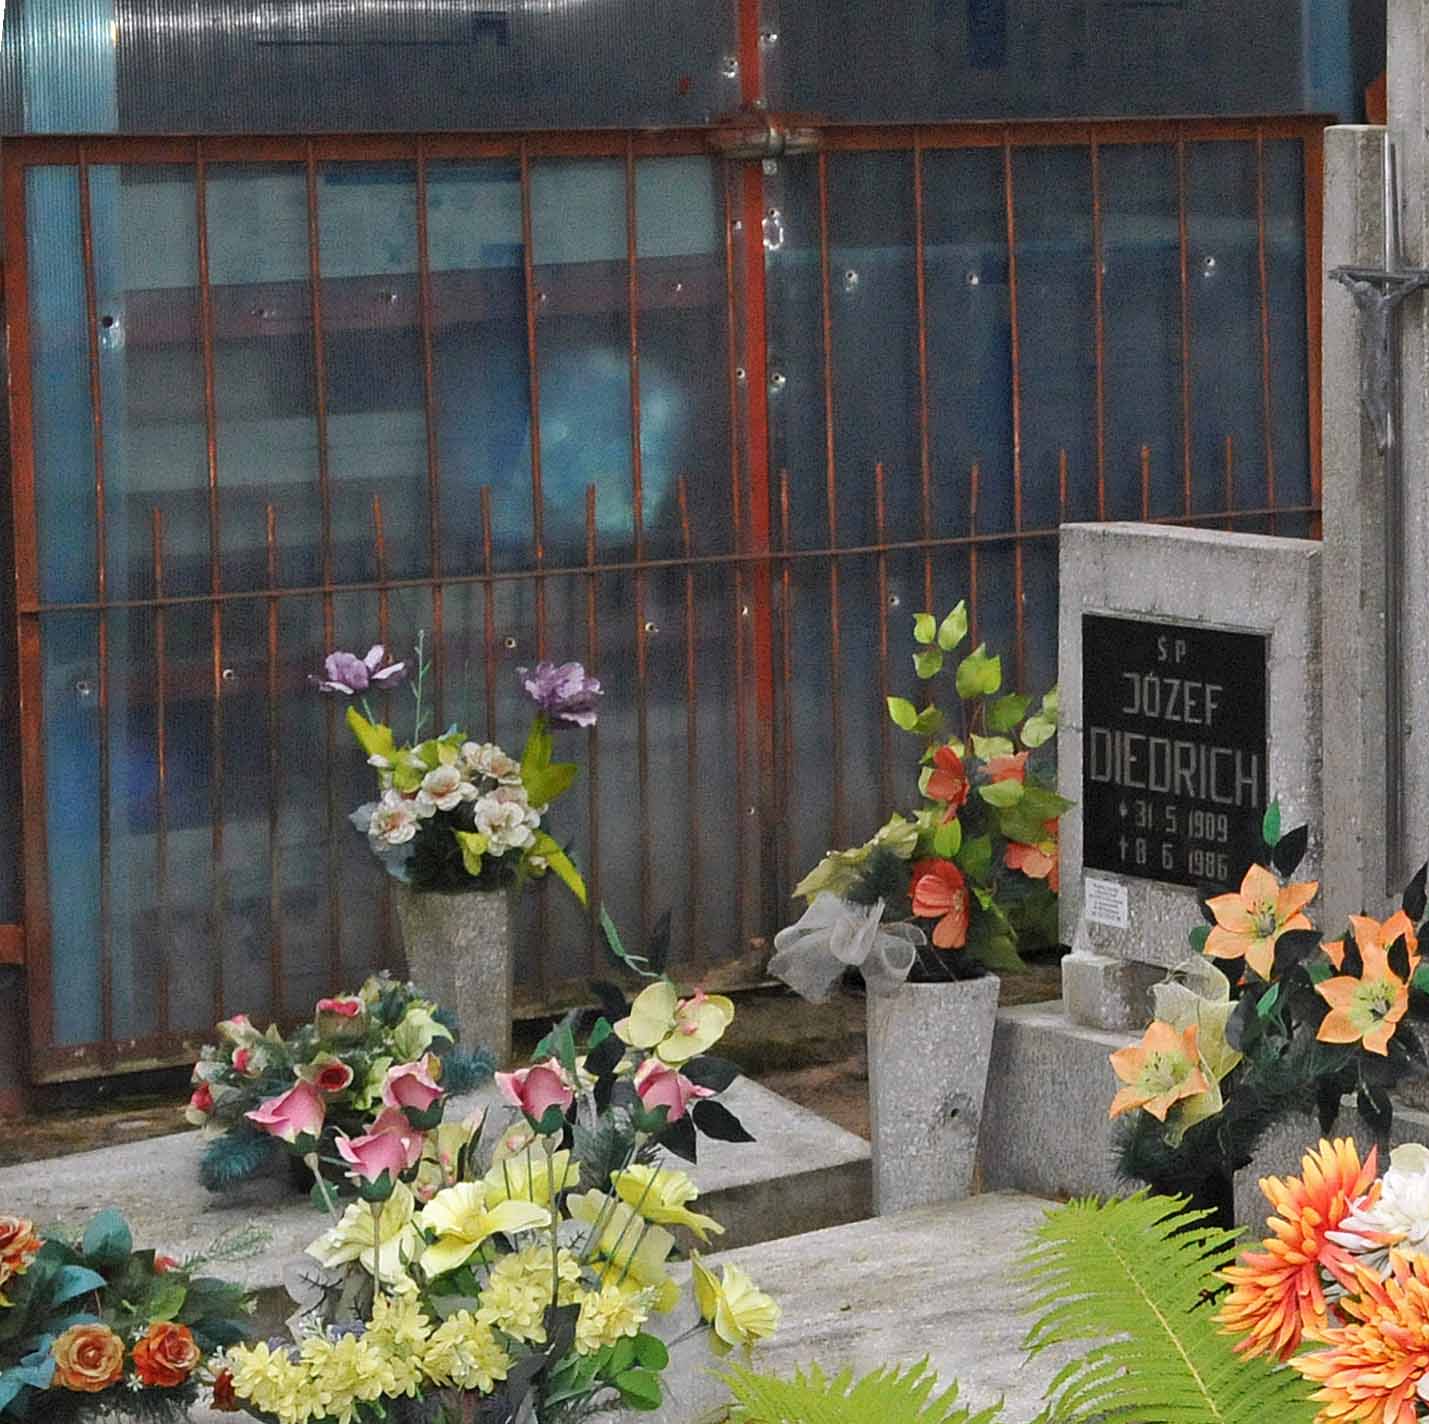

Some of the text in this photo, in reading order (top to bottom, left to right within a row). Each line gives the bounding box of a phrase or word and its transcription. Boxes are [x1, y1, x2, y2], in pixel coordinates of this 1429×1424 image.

[1121, 671, 1224, 727] JÓZEF
[1089, 725, 1260, 809] DIEDRICH
[1164, 804, 1178, 834] 5
[1188, 809, 1229, 843] 1909
